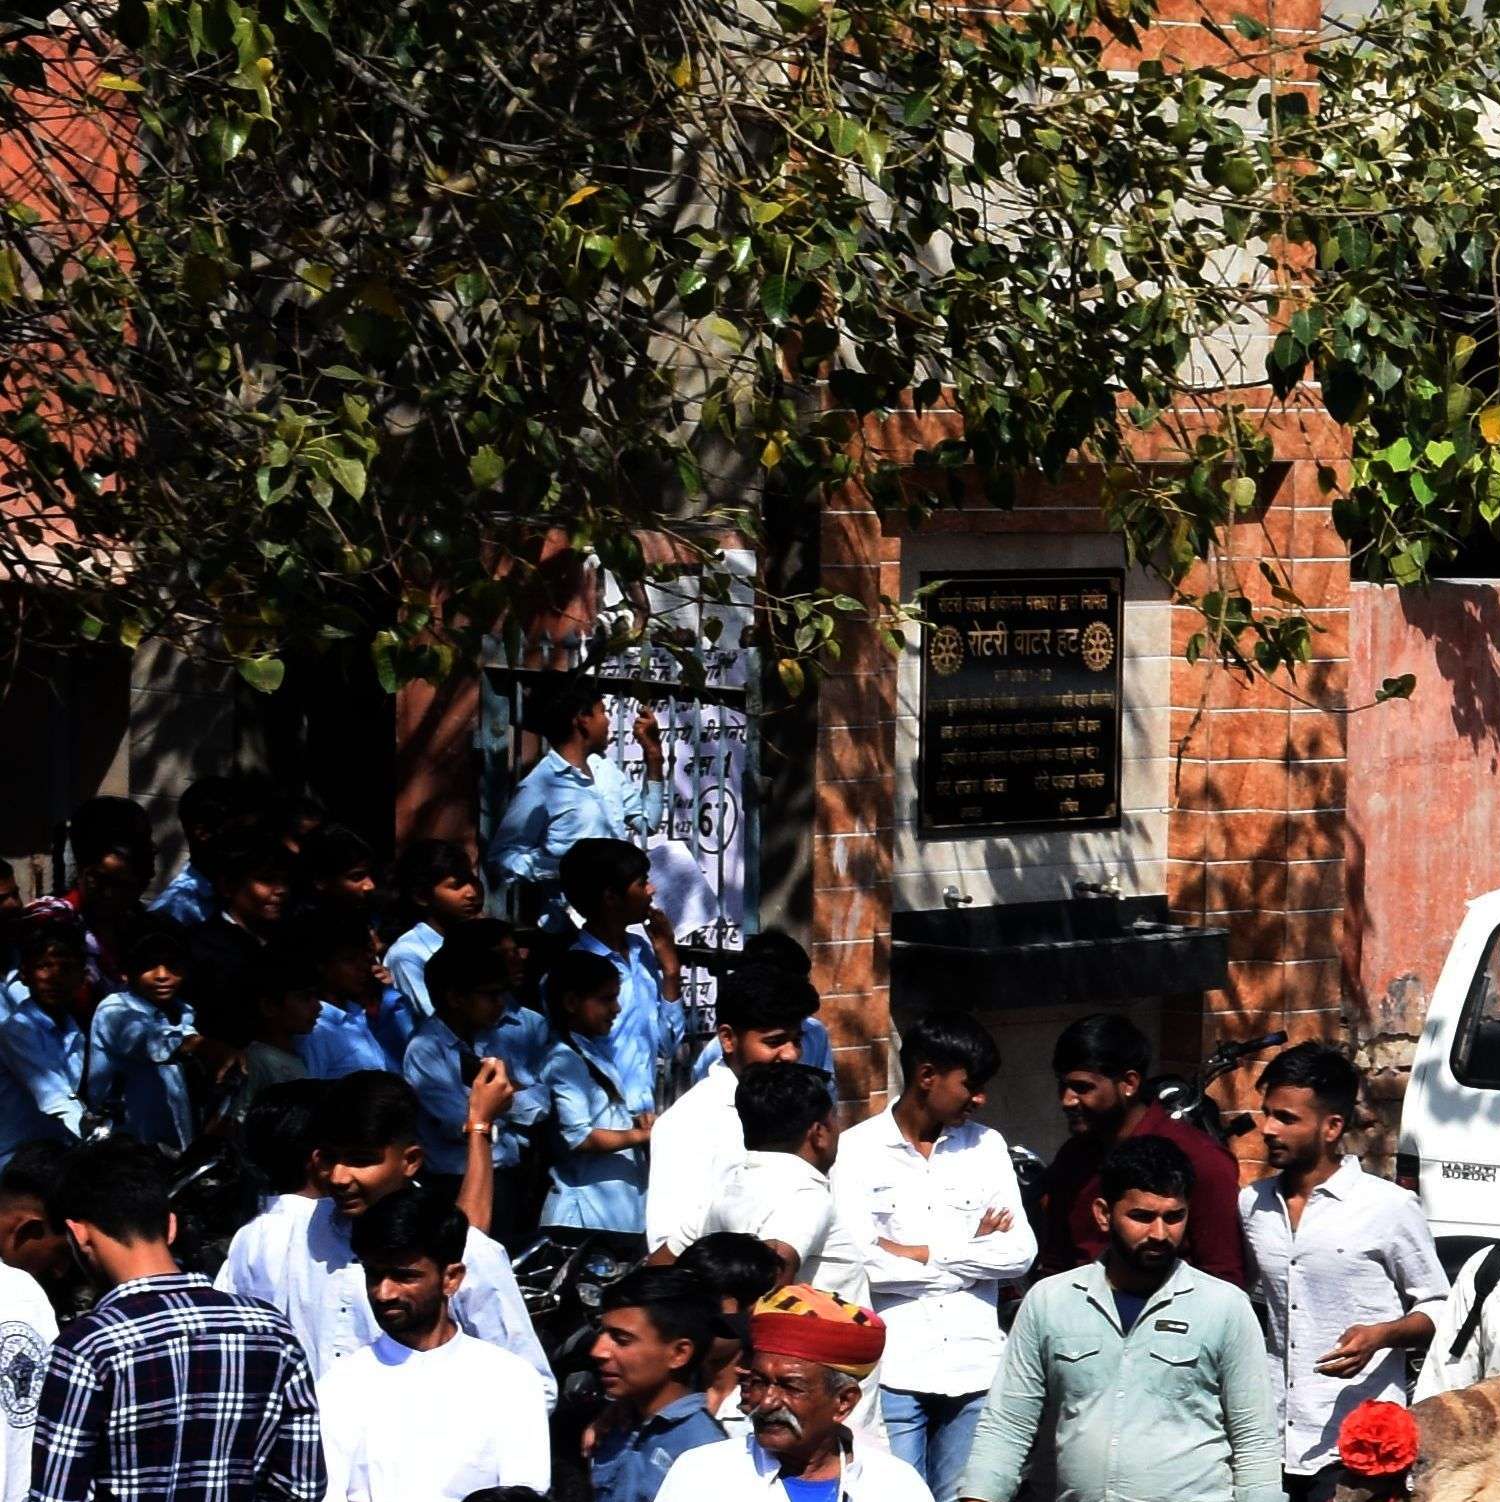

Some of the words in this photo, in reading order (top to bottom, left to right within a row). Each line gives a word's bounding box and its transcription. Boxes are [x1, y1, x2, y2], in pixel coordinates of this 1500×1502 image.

[967, 619, 1009, 657] रोटरी
[1013, 628, 1051, 657] वाटर
[1055, 627, 1080, 658] हट
